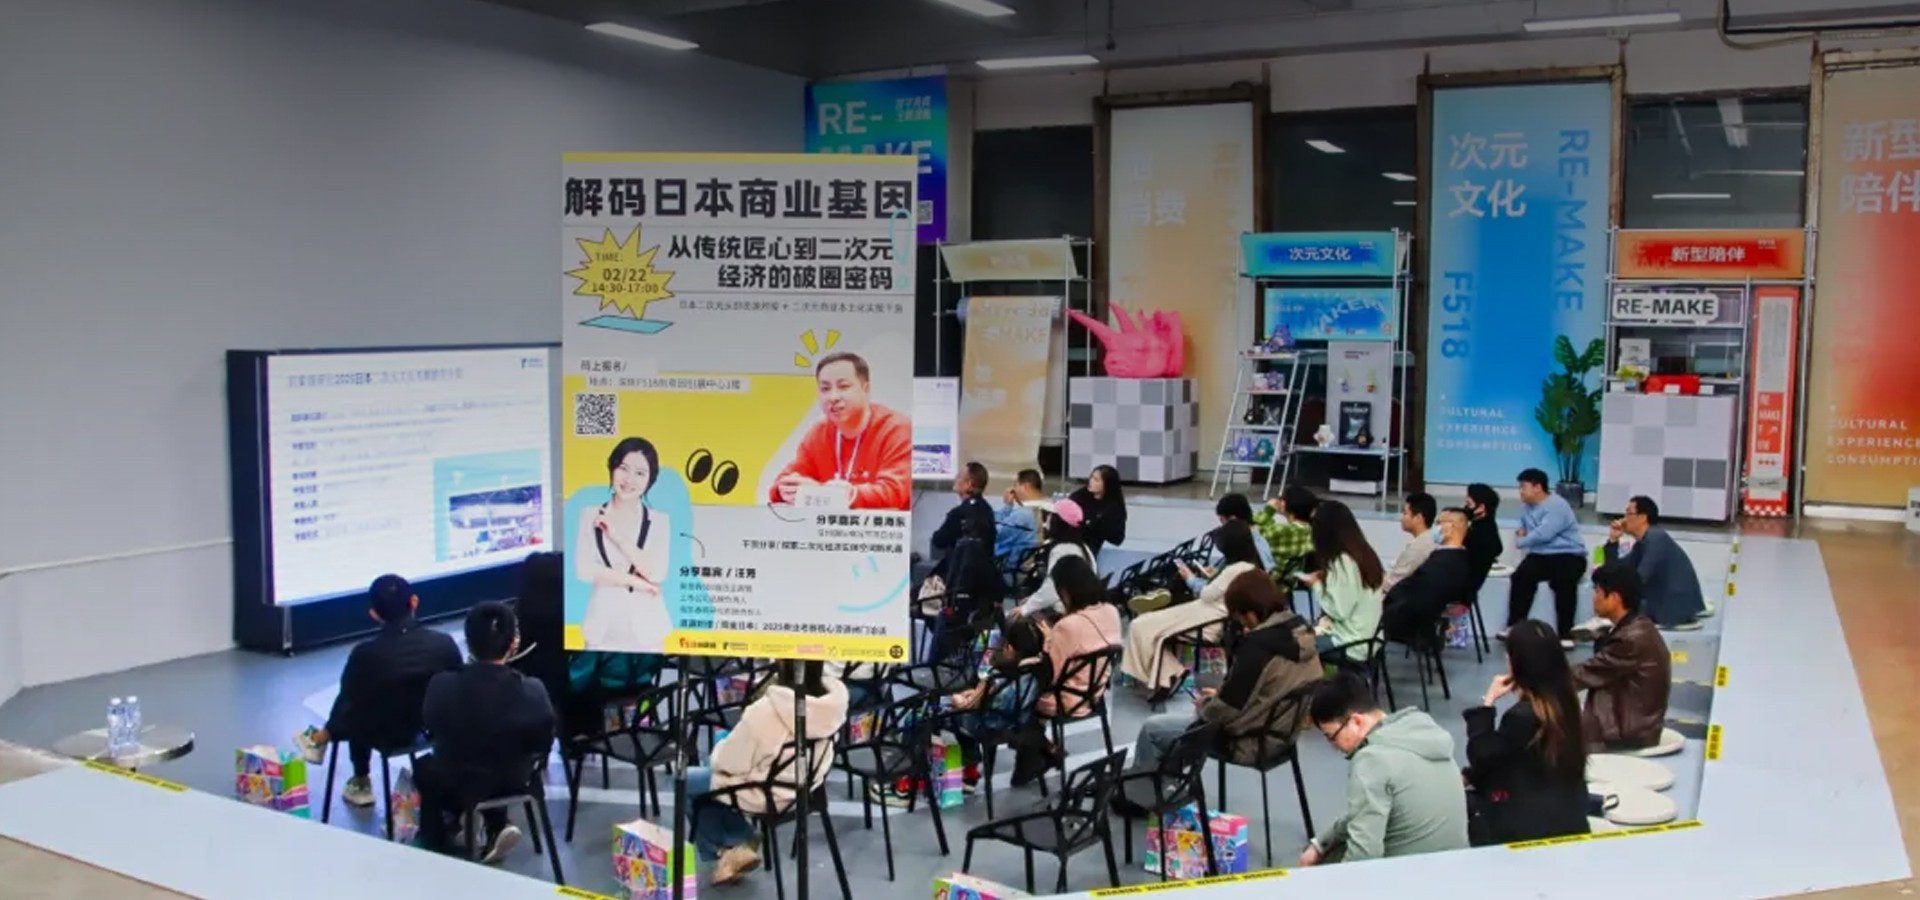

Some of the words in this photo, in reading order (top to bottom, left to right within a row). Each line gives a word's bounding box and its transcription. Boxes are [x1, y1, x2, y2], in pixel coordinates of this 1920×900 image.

[1450, 131, 1529, 170] 次元
[1843, 119, 1920, 161] 新型
[564, 177, 913, 219] 解码日本商业基因
[1449, 179, 1528, 218] 文化
[1839, 171, 1920, 214] 陪伴
[1555, 129, 1590, 311] RE-MAKE
[667, 234, 894, 262] 从传统匠心到二次元
[1289, 246, 1351, 261] 次元文化
[1671, 246, 1746, 262] 新型陪伴
[591, 282, 660, 295] 14:30-17:00
[602, 268, 647, 283] 02/22
[717, 264, 894, 290] 经济的破圈密码
[1441, 271, 1474, 359] F518
[1616, 298, 1715, 316] RE-MAKE
